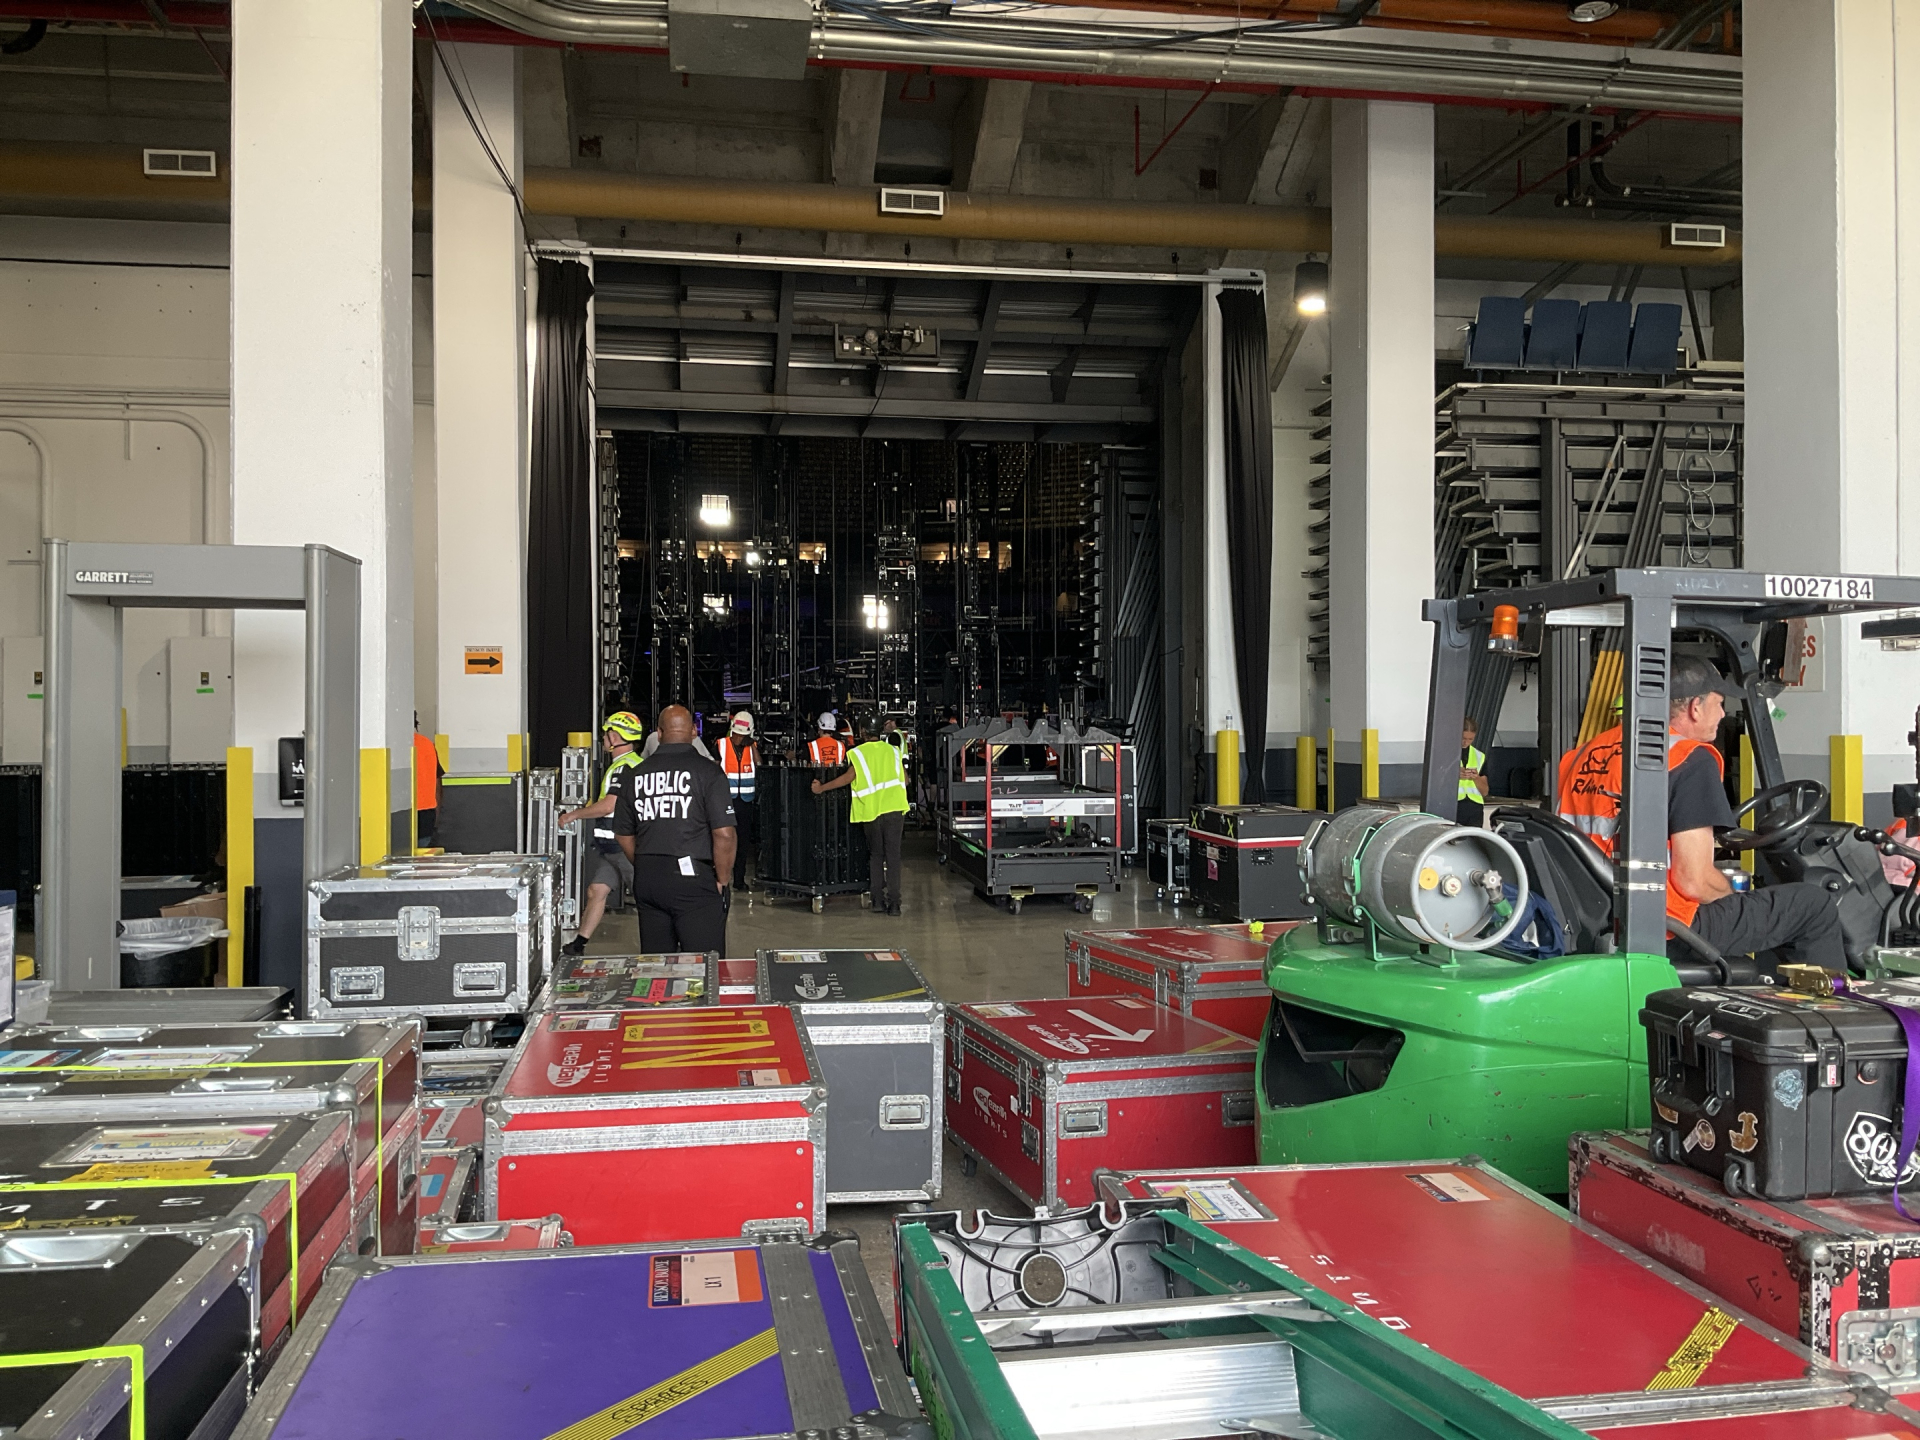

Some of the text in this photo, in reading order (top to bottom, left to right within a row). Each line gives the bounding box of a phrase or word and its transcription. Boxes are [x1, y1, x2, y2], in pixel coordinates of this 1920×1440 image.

[76, 571, 128, 583] GARRETT
[1768, 576, 1872, 599] 10027184
[634, 770, 691, 798] PUBLIC
[634, 795, 692, 821] SAFETY
